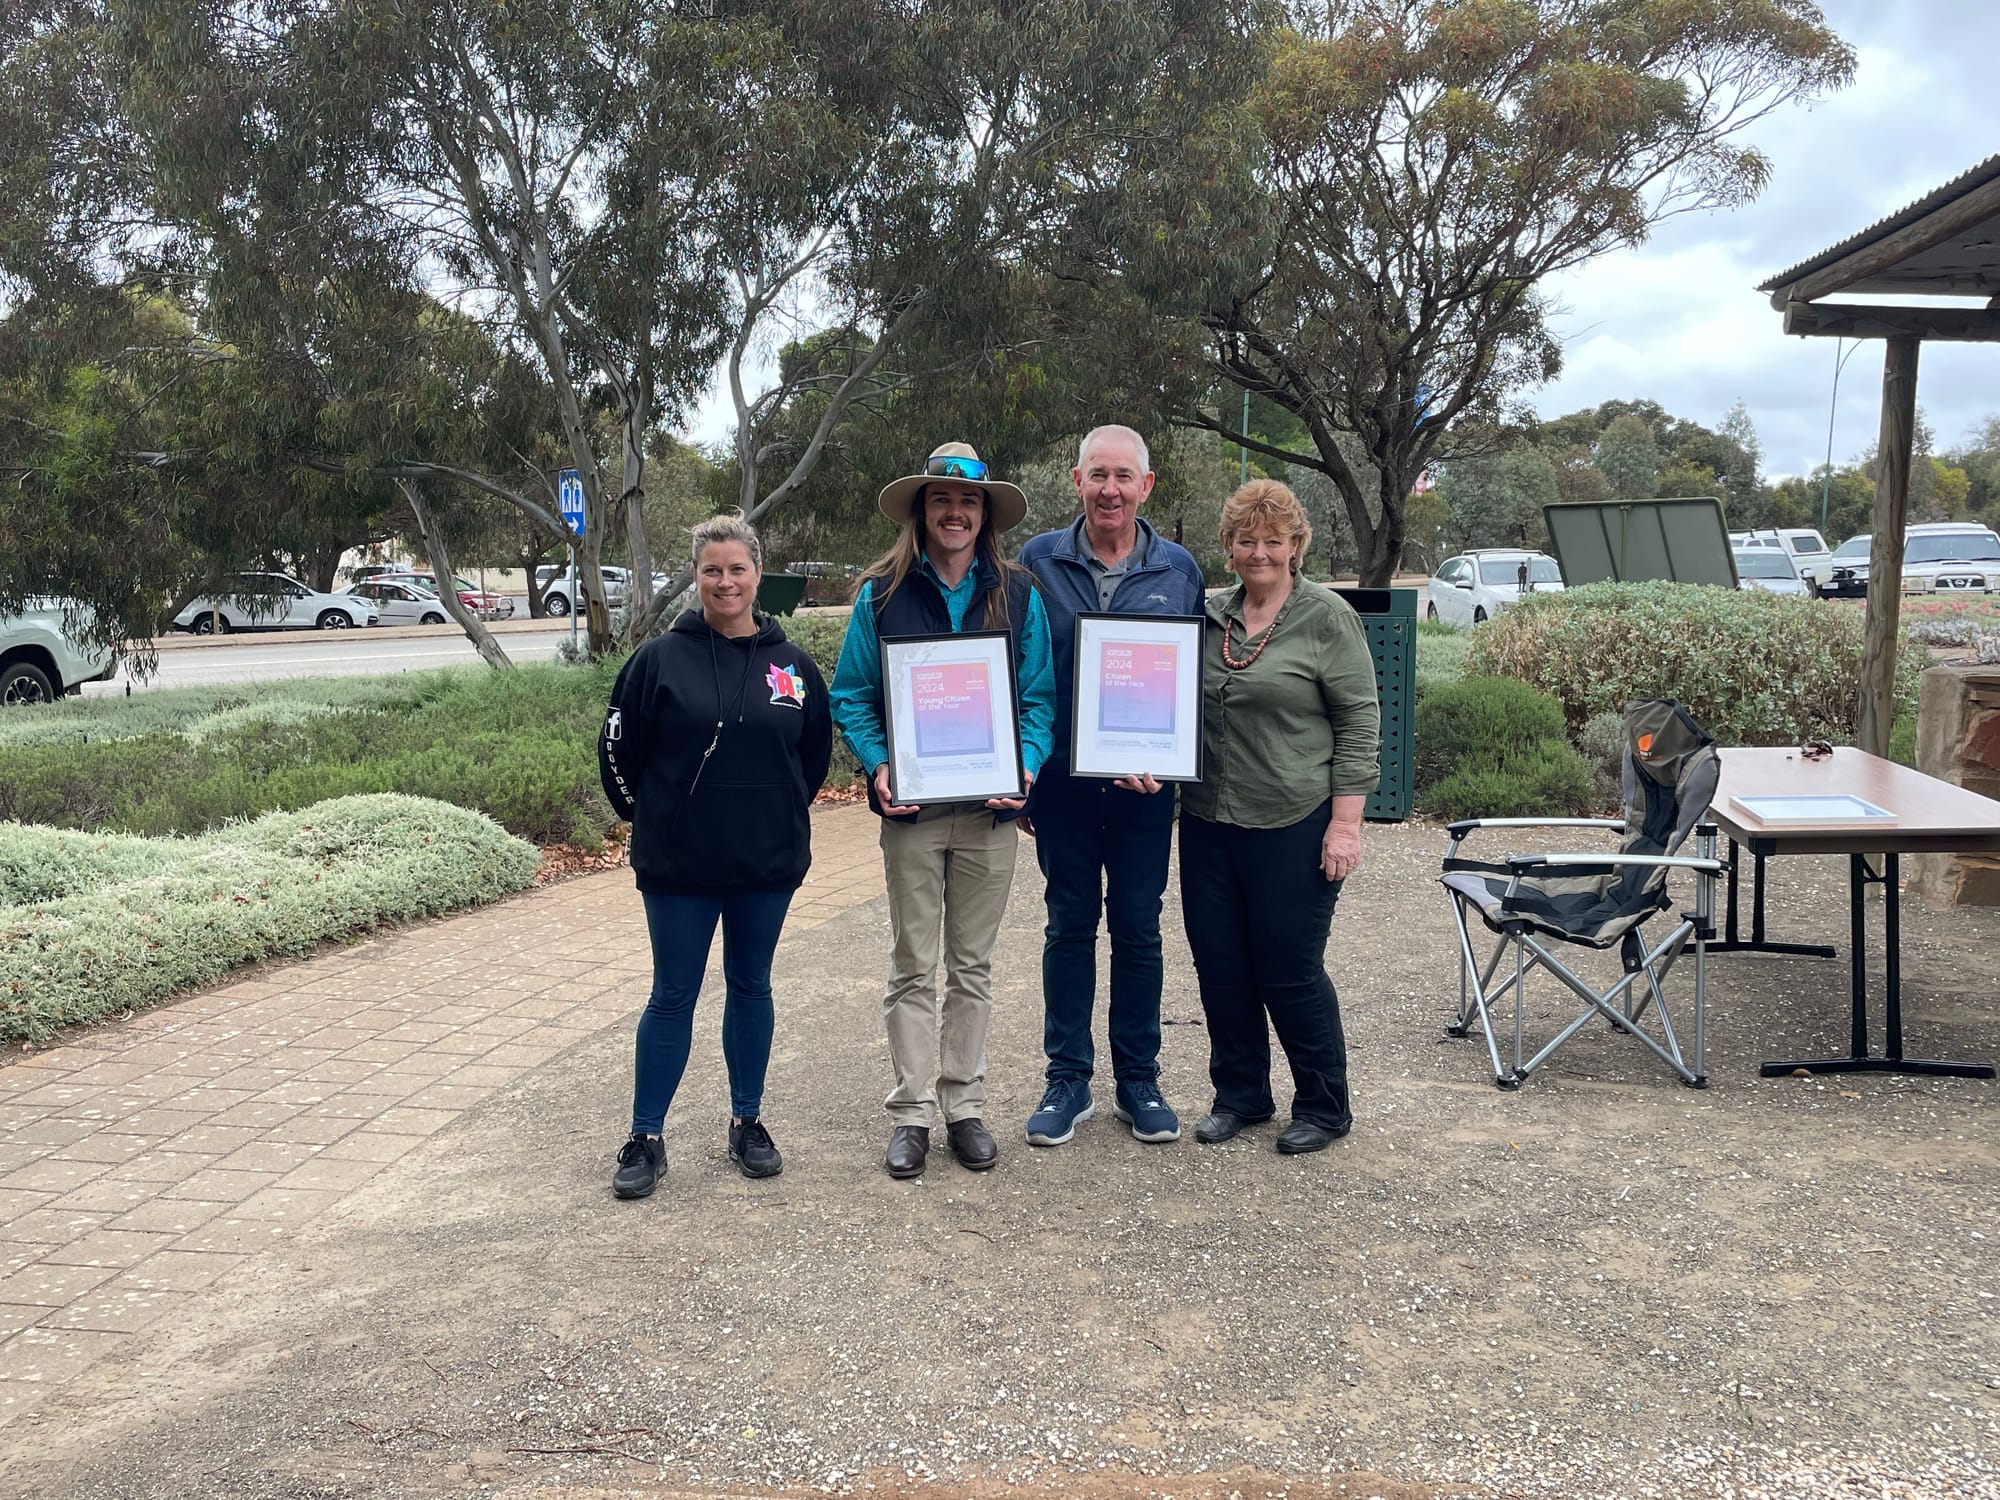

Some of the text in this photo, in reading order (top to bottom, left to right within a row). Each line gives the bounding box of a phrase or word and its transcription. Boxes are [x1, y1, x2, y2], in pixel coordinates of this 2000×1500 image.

[1106, 659, 1132, 669] 2024
[918, 682, 944, 694] 2024
[606, 741, 635, 805] GOYDER
